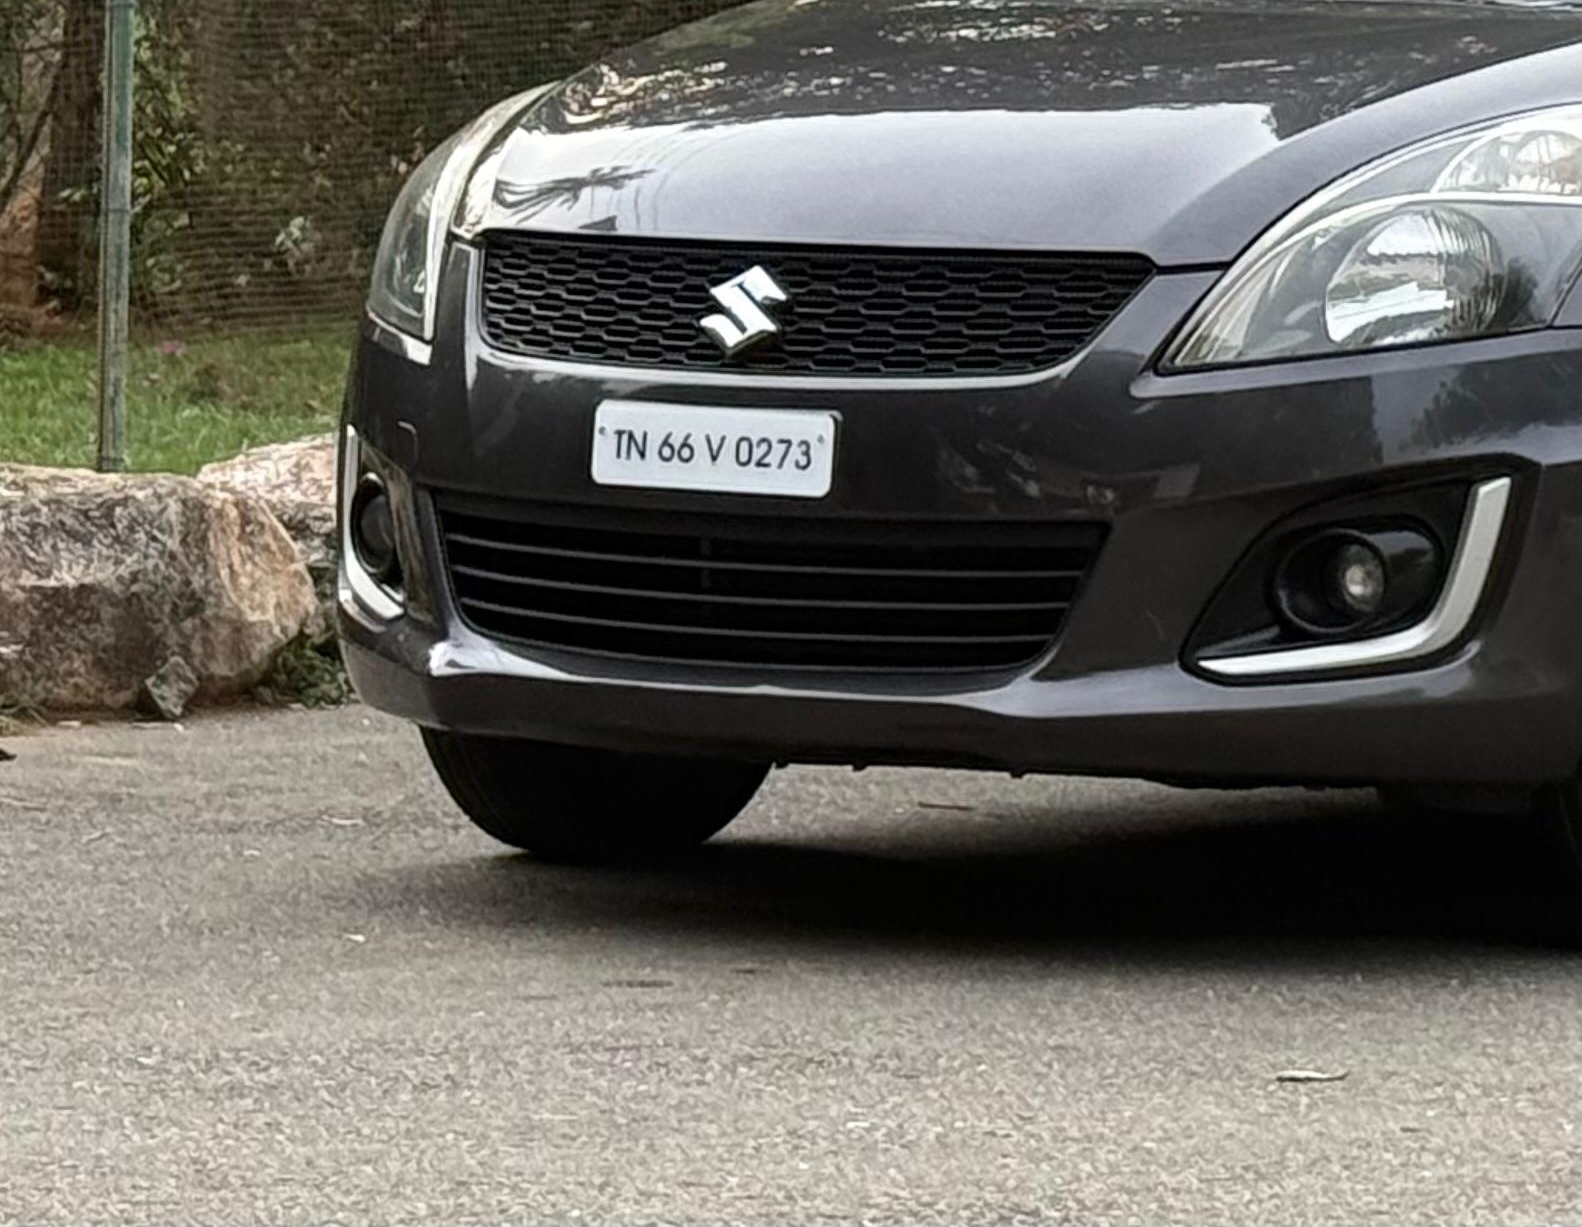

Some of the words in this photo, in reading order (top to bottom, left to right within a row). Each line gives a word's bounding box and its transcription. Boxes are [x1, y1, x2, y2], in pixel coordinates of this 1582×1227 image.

[614, 429, 648, 461] TN
[657, 431, 695, 464] 66
[705, 434, 727, 466] V
[735, 436, 812, 471] 0273
